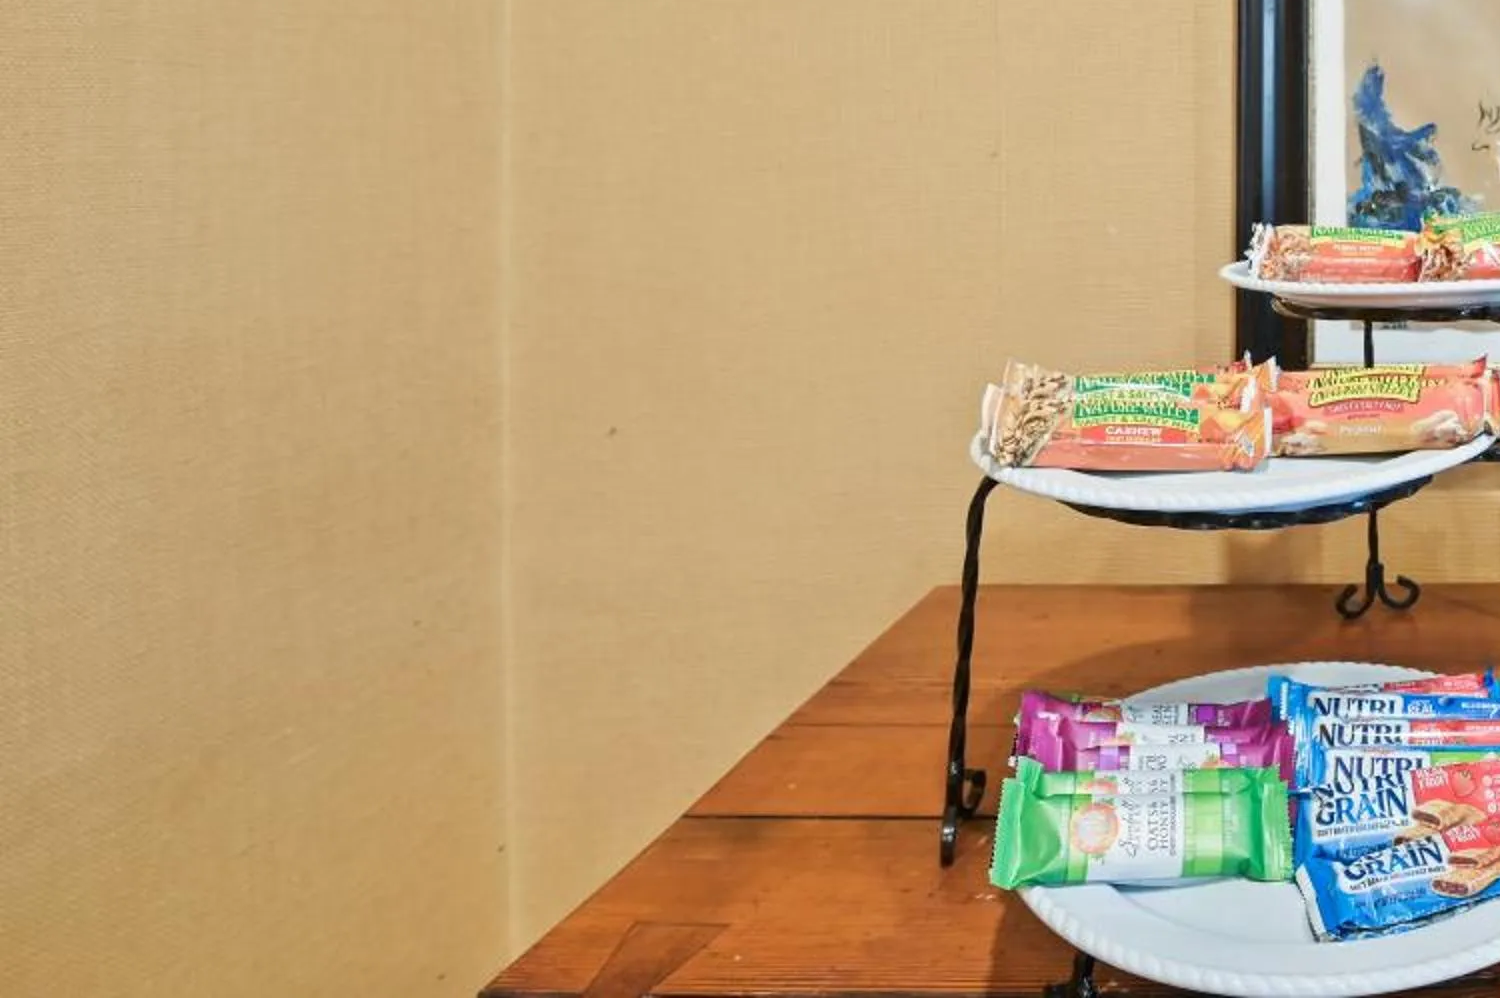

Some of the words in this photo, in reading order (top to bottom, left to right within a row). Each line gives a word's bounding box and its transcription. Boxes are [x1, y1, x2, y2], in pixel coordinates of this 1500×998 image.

[1314, 697, 1395, 716] NUTRI
[1320, 723, 1402, 747] NUTRI
[1334, 757, 1423, 786] NUTRI
[1159, 800, 1169, 850] HONEY
